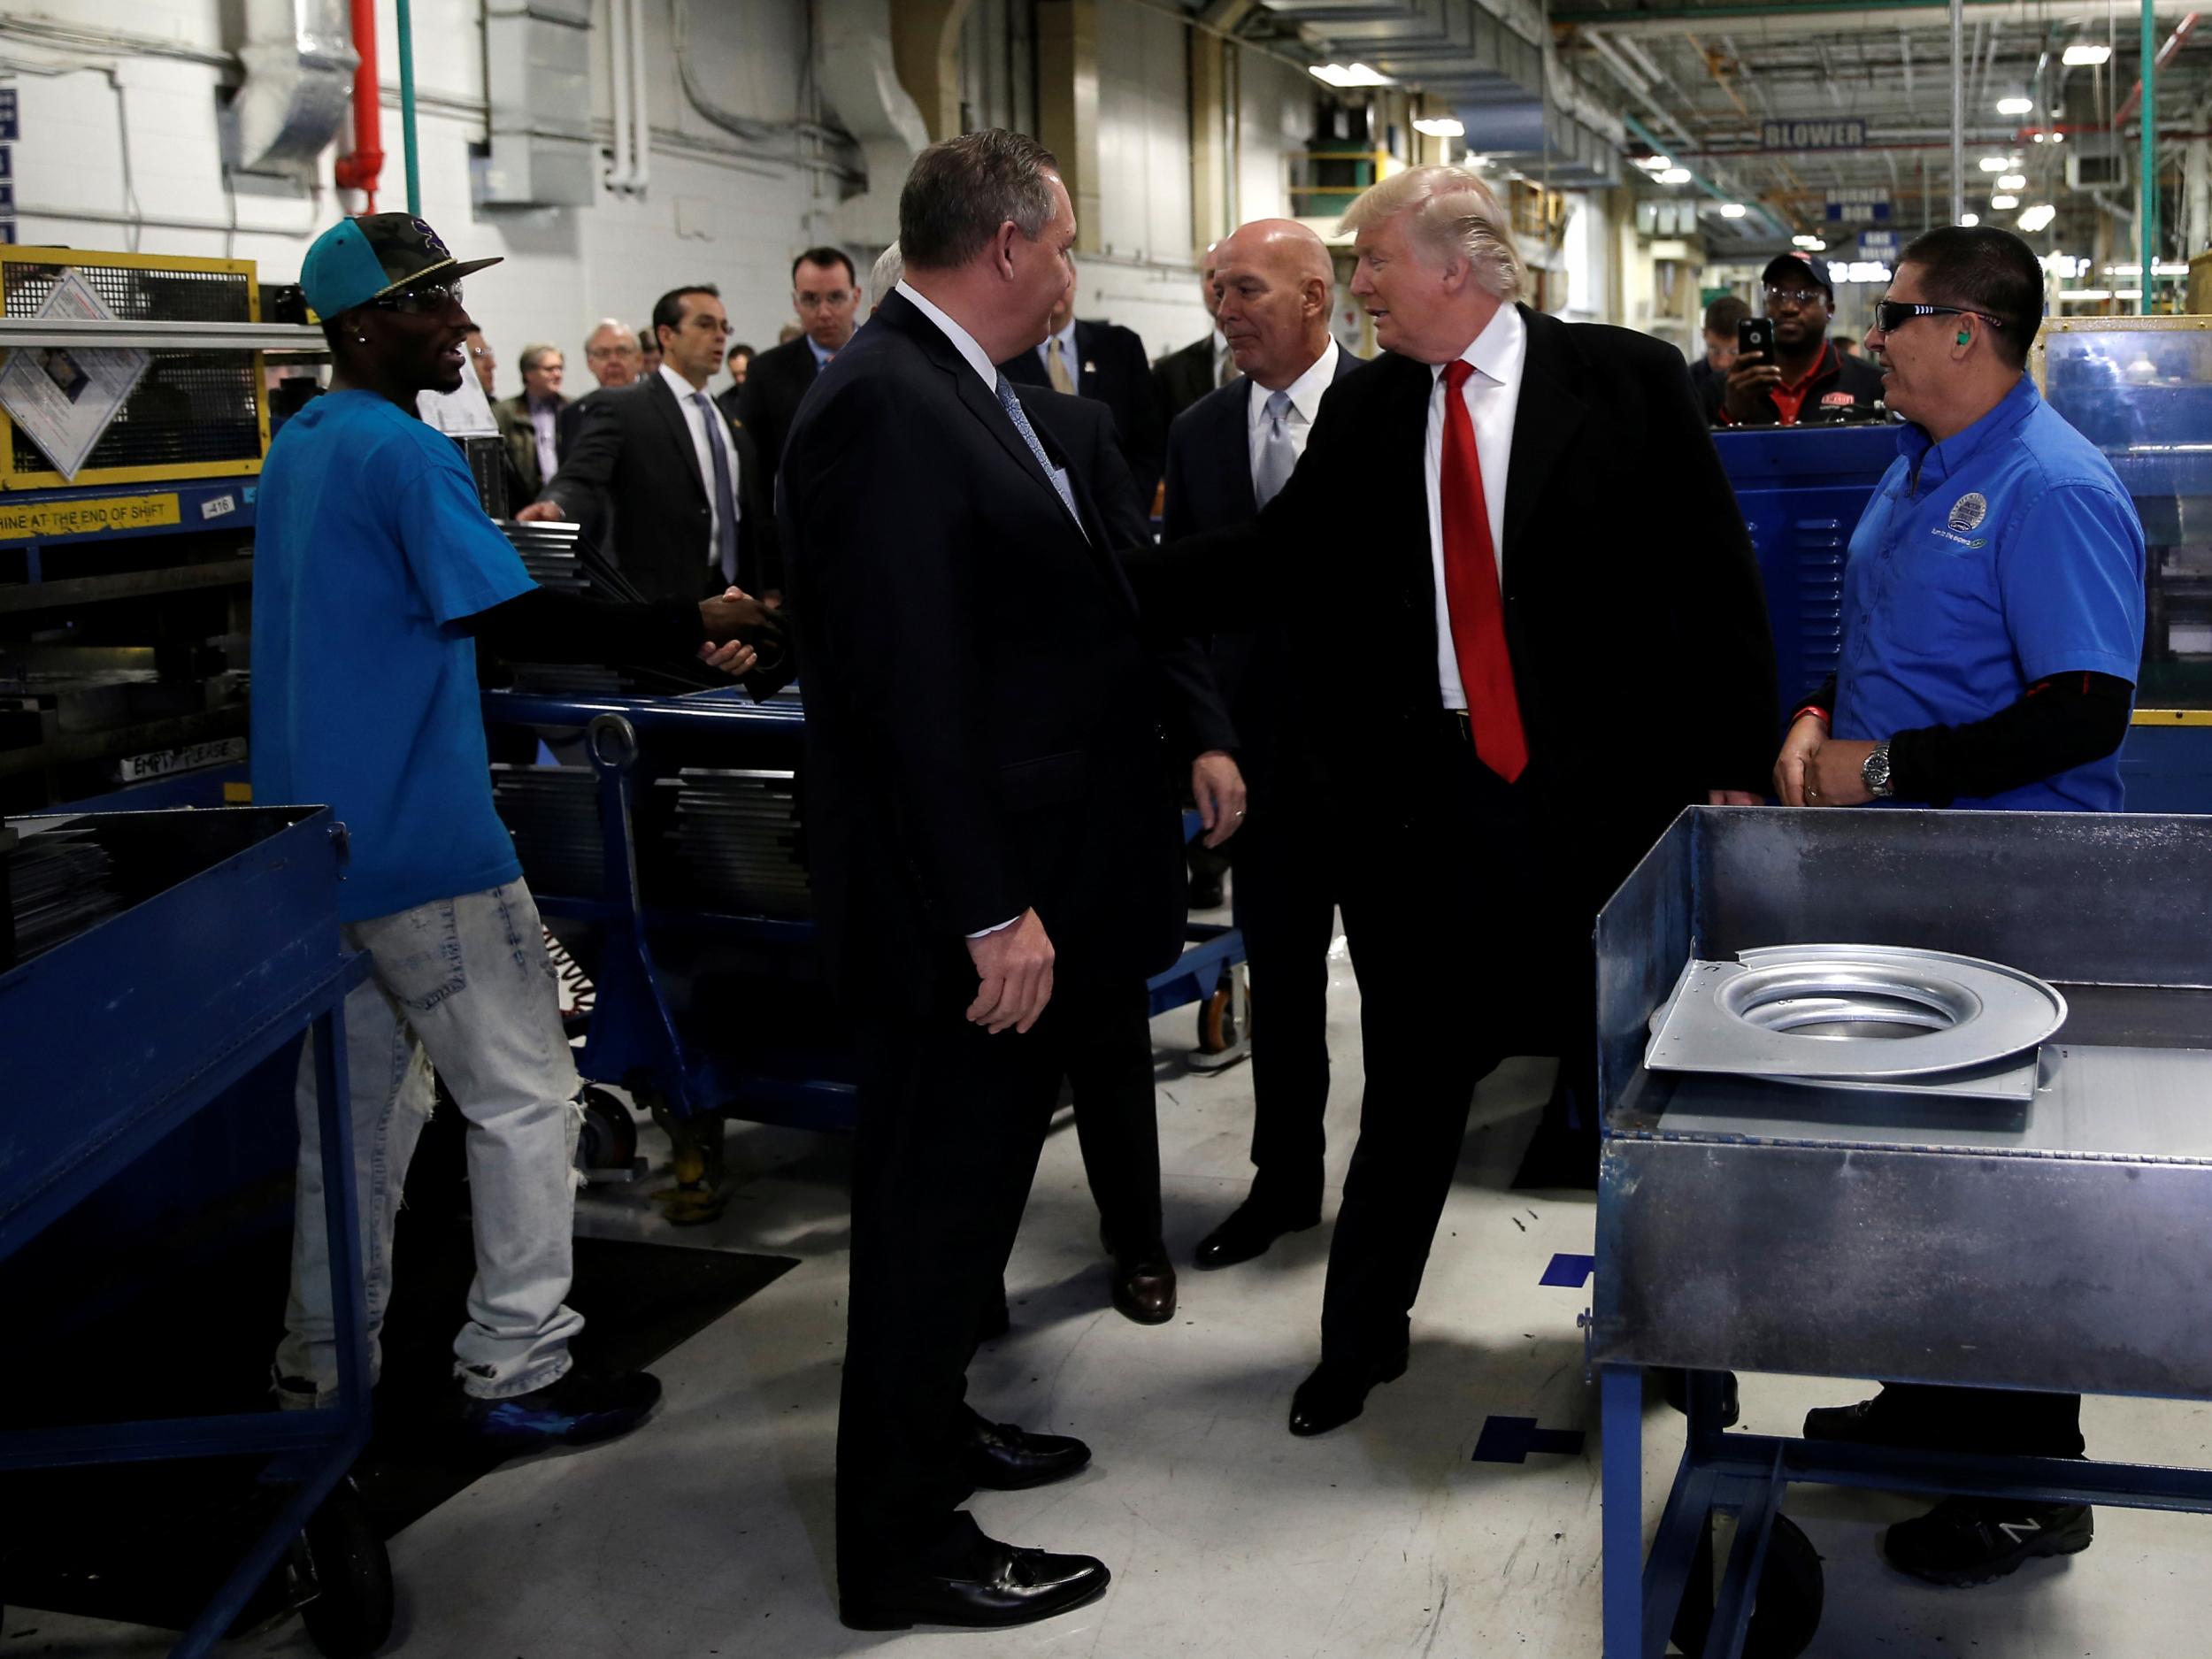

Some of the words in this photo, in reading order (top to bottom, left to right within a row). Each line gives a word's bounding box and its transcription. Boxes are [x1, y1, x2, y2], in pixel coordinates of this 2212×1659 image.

[1764, 123, 1864, 149] BLOWER
[31, 513, 48, 527] AT
[52, 511, 78, 526] THE
[81, 508, 108, 524] END
[111, 507, 127, 521] OF
[131, 503, 165, 519] SHIFT
[134, 752, 177, 776] EMPTY
[184, 741, 230, 766] PLEASE
